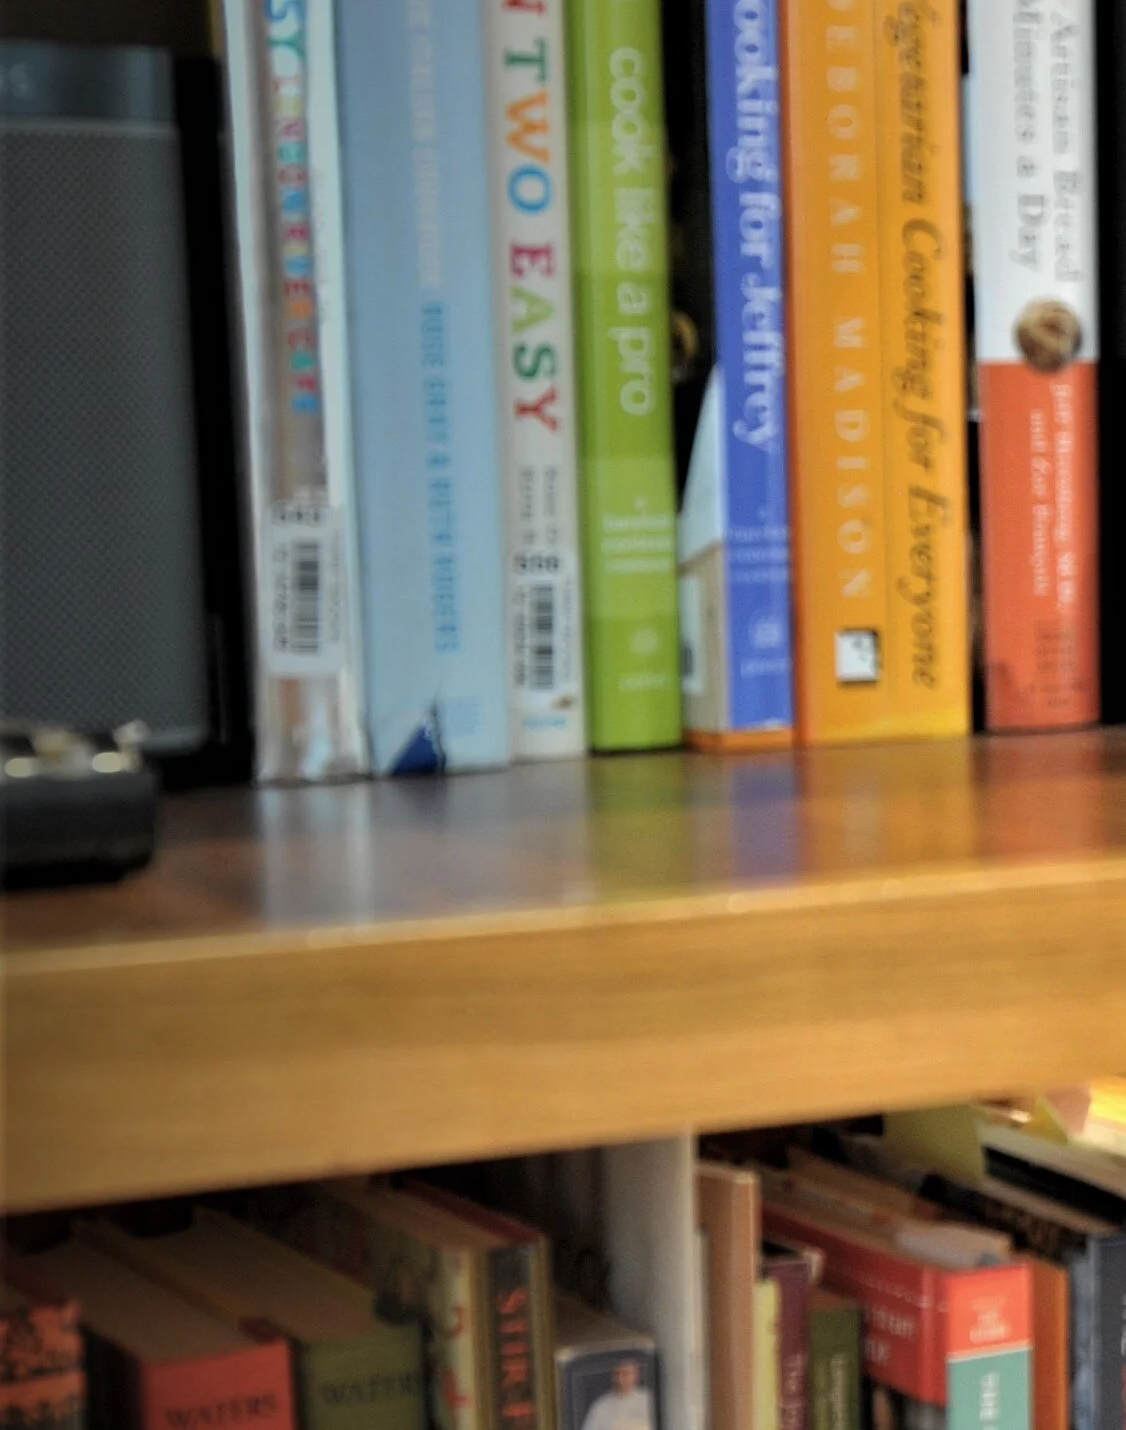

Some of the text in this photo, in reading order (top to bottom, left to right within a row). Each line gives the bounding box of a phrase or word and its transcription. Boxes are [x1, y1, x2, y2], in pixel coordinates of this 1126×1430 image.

[503, 39, 552, 215] TWO
[1050, 12, 1087, 155] Artisan
[1016, 156, 1039, 178] a
[1052, 170, 1087, 281] Bread
[608, 47, 659, 416] cook like a pro
[738, 191, 781, 271] for
[1009, 194, 1047, 271] Day
[509, 242, 559, 432] EASY
[894, 219, 945, 401] Cooking
[832, 317, 871, 599] MADISON
[892, 399, 950, 475] for
[896, 484, 954, 690] Everyone
[782, 1353, 806, 1395] The
[979, 1372, 999, 1421] THE
